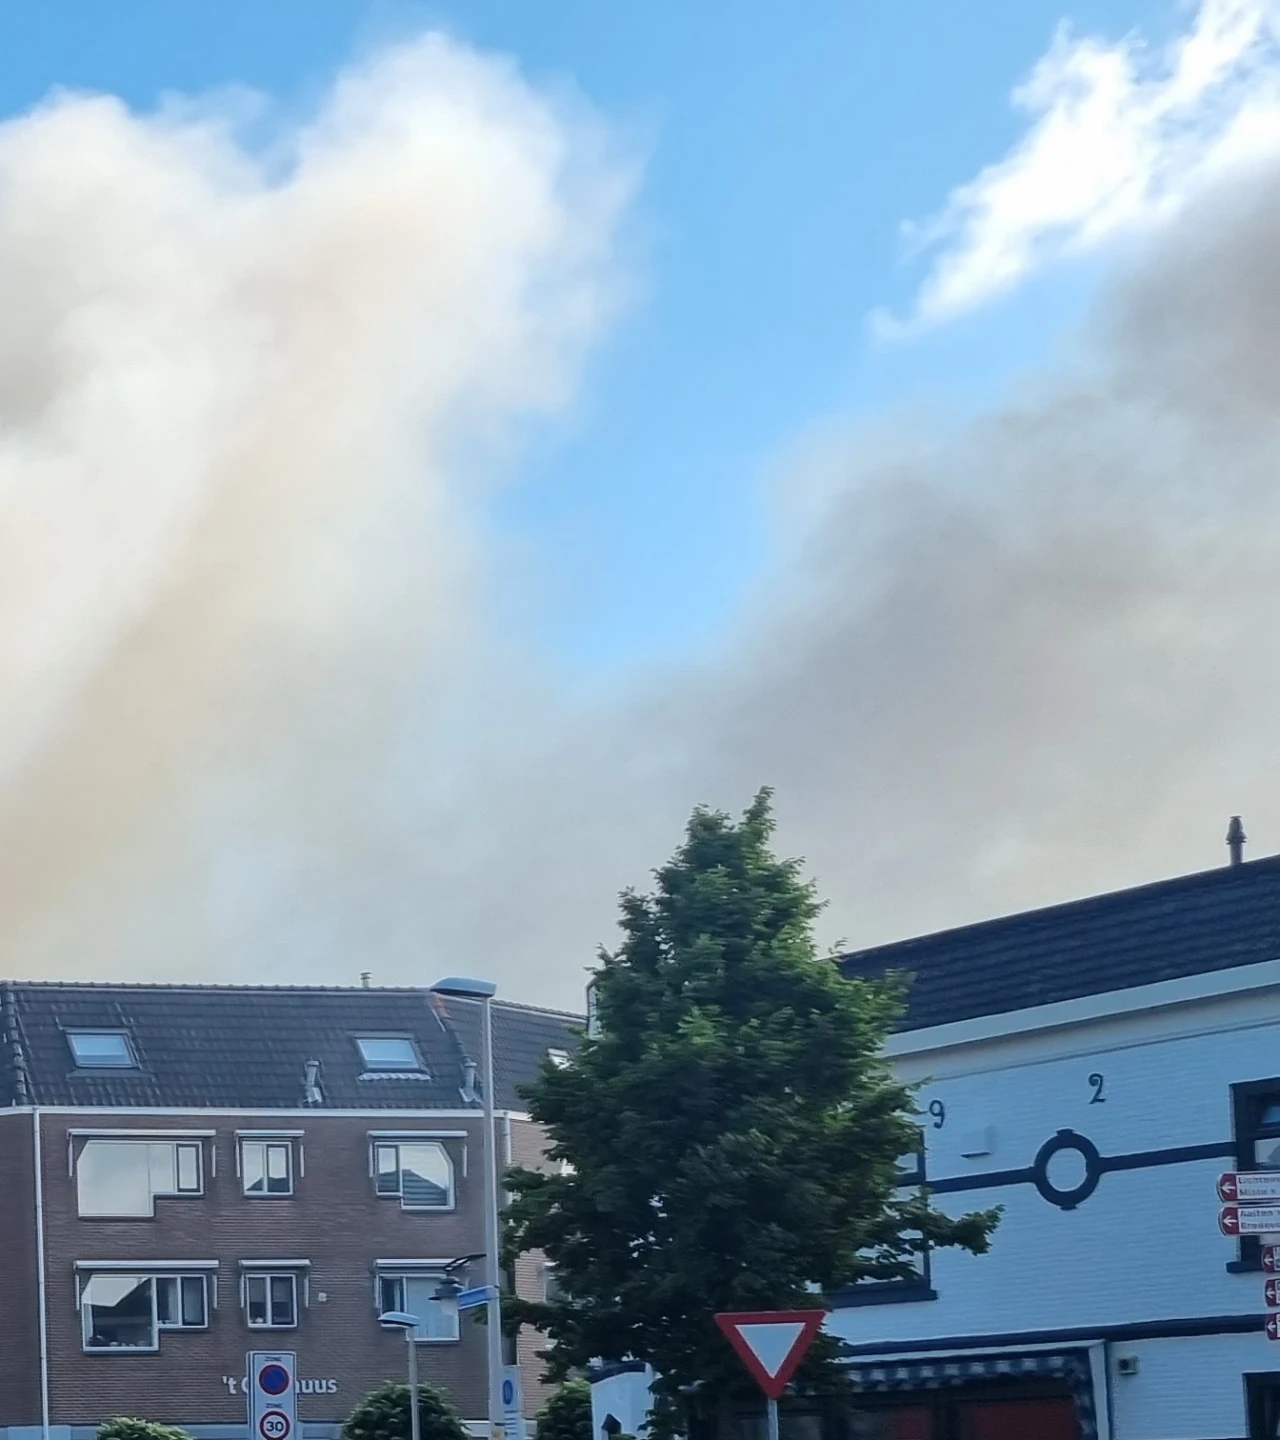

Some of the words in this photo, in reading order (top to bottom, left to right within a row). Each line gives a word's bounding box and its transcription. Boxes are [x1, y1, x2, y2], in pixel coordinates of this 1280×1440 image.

[929, 1099, 945, 1129] 9
[1088, 1073, 1107, 1105] 2
[266, 1421, 285, 1432] 30
